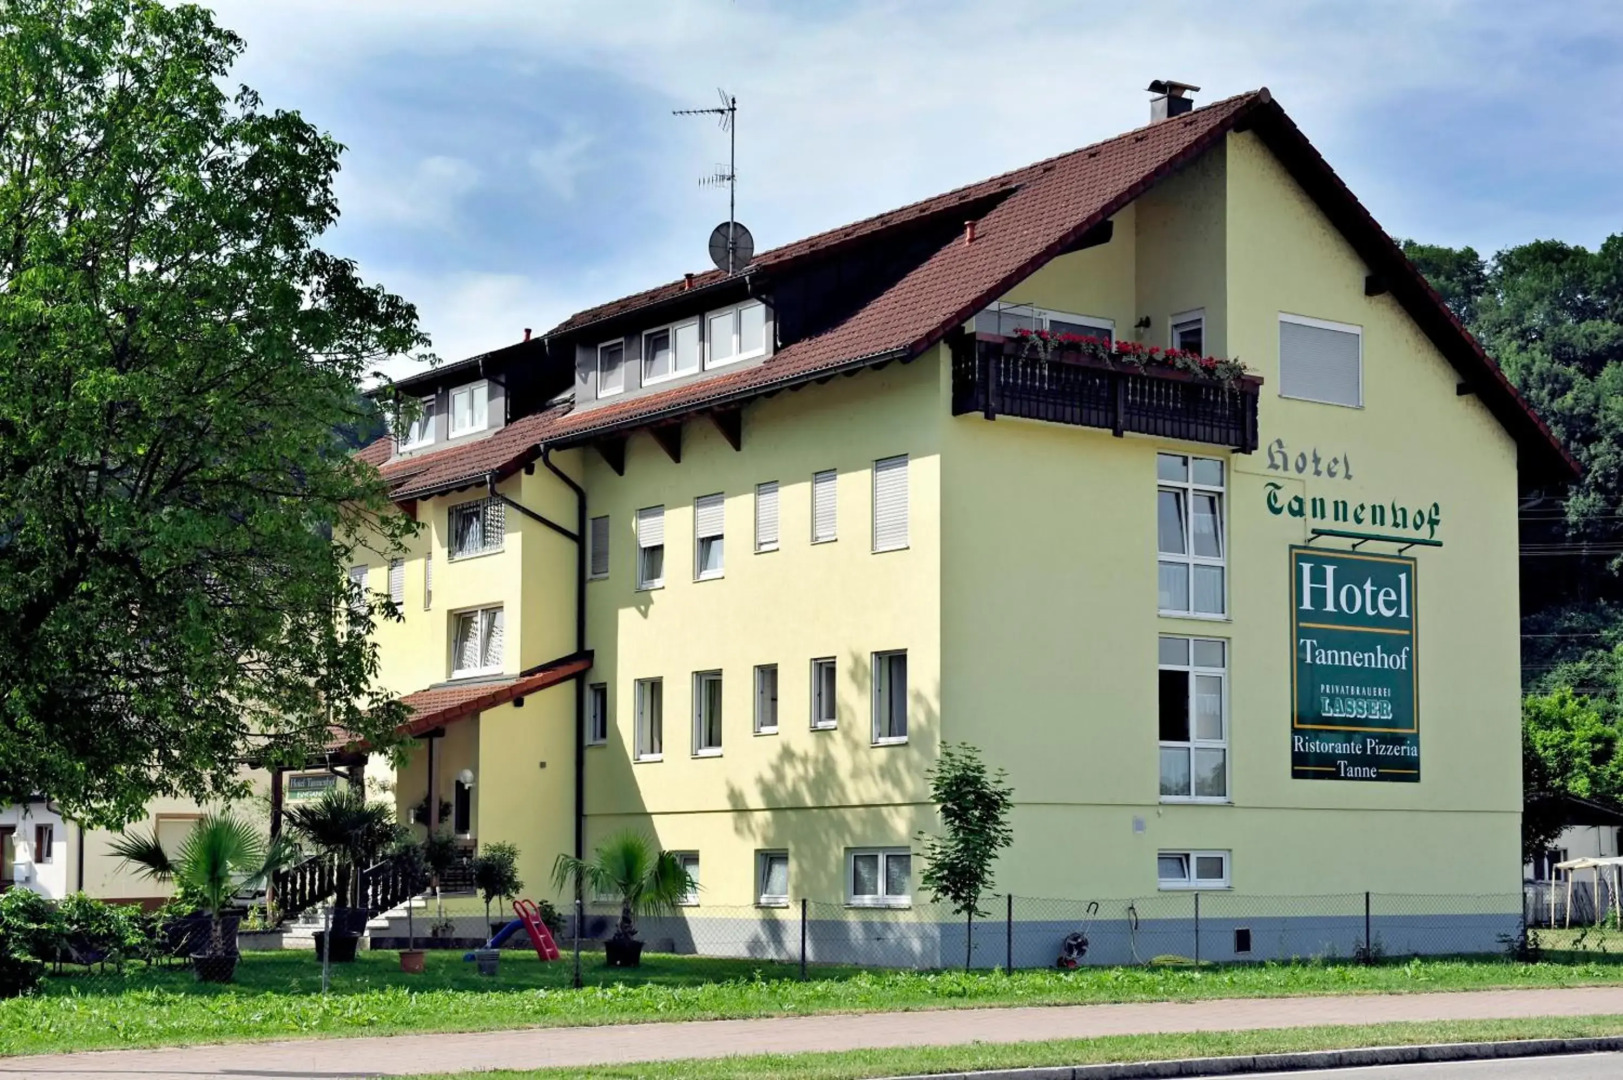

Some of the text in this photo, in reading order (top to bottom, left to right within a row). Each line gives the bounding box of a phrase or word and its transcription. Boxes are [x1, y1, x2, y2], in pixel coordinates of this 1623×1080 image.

[1267, 438, 1353, 480] Hotel
[1264, 482, 1441, 539] Tannenhof
[1299, 562, 1410, 618] Hotel
[1299, 638, 1410, 670] Tannenhof
[1320, 684, 1392, 697] PRIVATBRAUEREI
[1320, 697, 1393, 720] LASSER
[1293, 735, 1418, 757] Ristorante Pizzeria
[1337, 760, 1377, 778] Tanne
